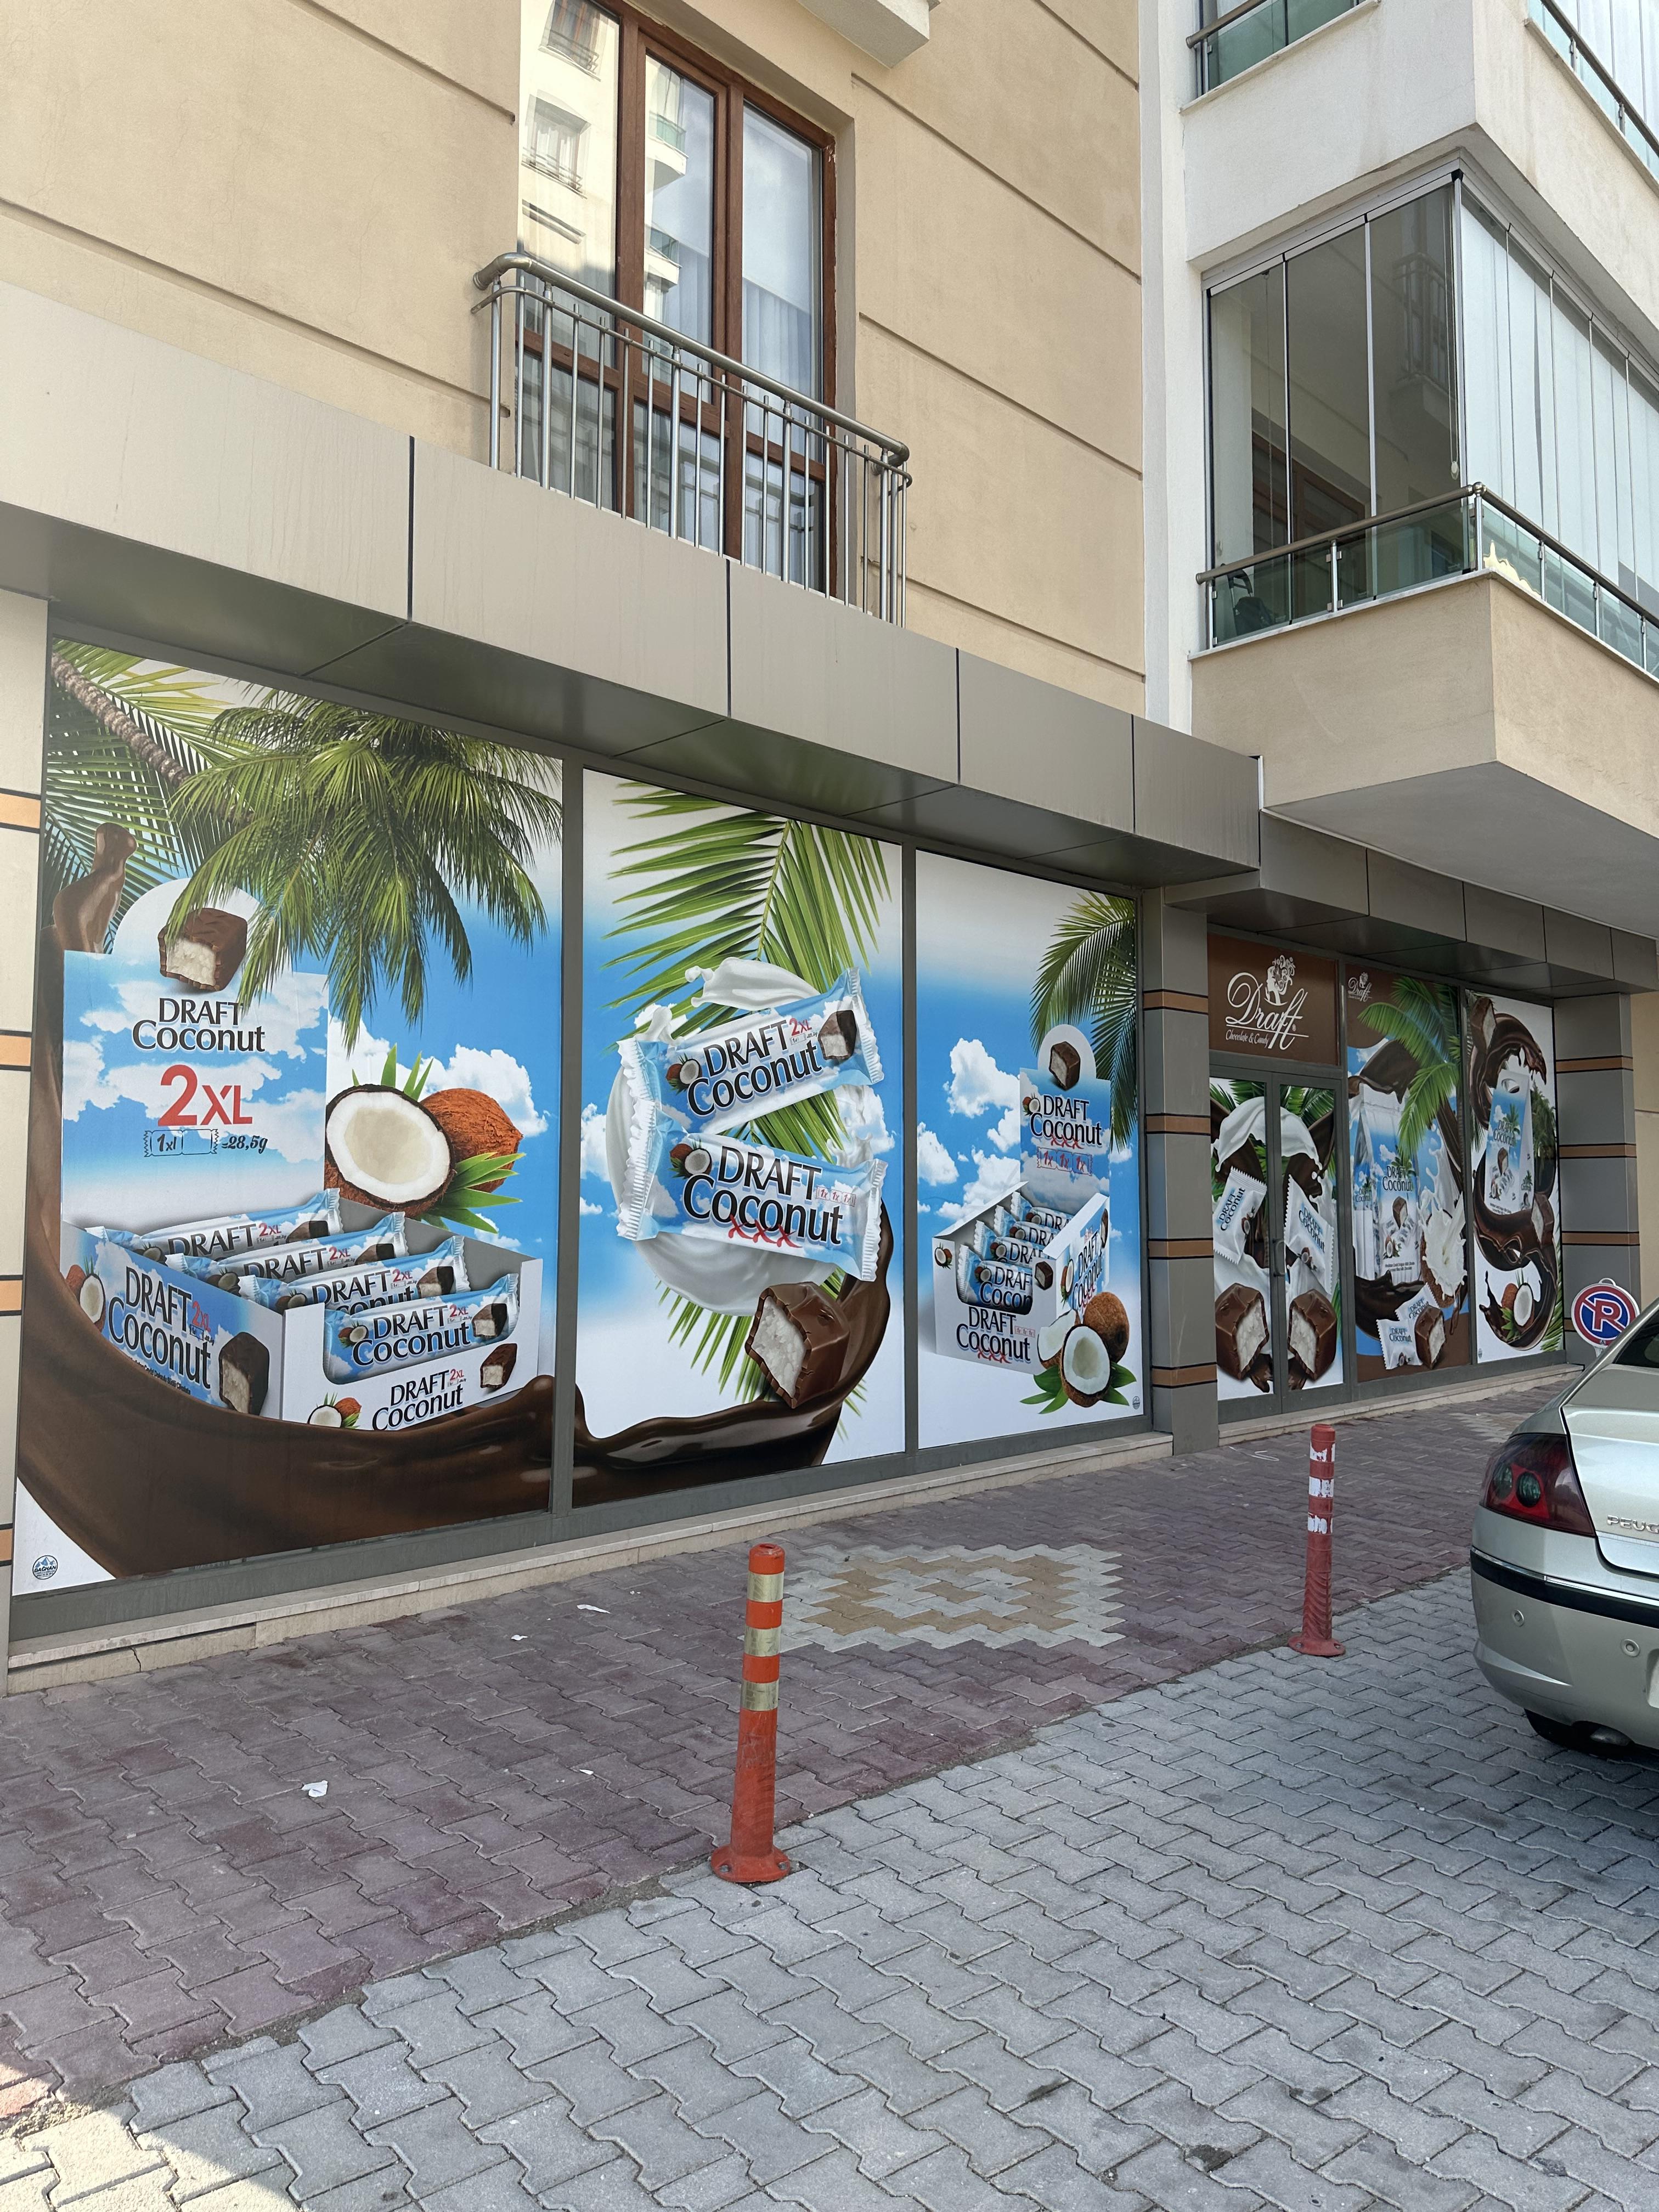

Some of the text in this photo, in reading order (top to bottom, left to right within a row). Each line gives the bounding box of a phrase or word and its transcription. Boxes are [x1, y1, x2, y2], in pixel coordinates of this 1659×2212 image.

[159, 997, 244, 1025] DRAFT
[1226, 972, 1308, 1049] Draft
[133, 1019, 266, 1051] Coconut
[703, 1020, 787, 1077] DRAFT
[158, 1064, 252, 1126] 2XL
[687, 1040, 822, 1115] Coconut
[1043, 1095, 1089, 1121] DRAFT
[1030, 1113, 1102, 1146] Coconut
[718, 1146, 822, 1200] DRAFT
[684, 1175, 843, 1244] Coconut
[1219, 1193, 1235, 1221] DRAFT
[1221, 1187, 1245, 1231] Coconut
[168, 1223, 257, 1256] DRAFT
[1079, 1231, 1098, 1280] DRAFT
[244, 1248, 327, 1279] DRAFT
[994, 1266, 1032, 1290] DRAF
[126, 1266, 192, 1331] DRAFT
[312, 1269, 391, 1304] DRAFT
[374, 1305, 448, 1339] DRAFT
[969, 1306, 1016, 1335] DRAFT
[109, 1297, 211, 1389] Coconut
[353, 1322, 471, 1365] Coconut
[956, 1323, 1030, 1361] Coconut
[372, 1384, 463, 1431] Coconut
[391, 1370, 449, 1407] DRAFT
